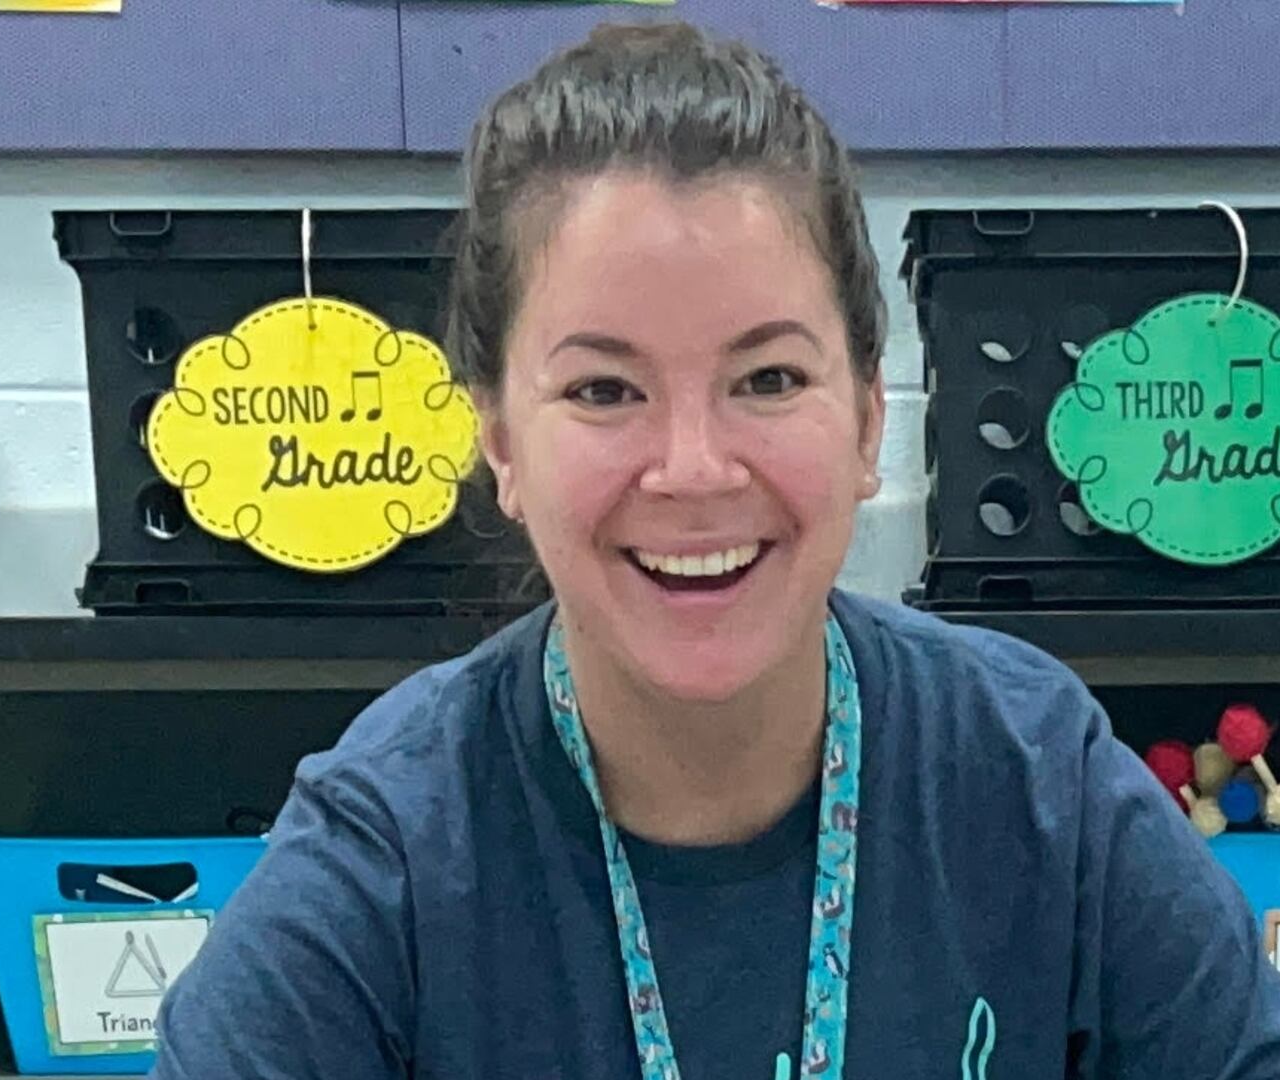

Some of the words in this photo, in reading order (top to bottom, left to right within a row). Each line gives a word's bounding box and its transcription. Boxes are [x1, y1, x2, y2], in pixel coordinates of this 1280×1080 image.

[212, 386, 329, 425] SECOND
[1115, 381, 1204, 419] THIRD
[261, 432, 423, 492] Grade
